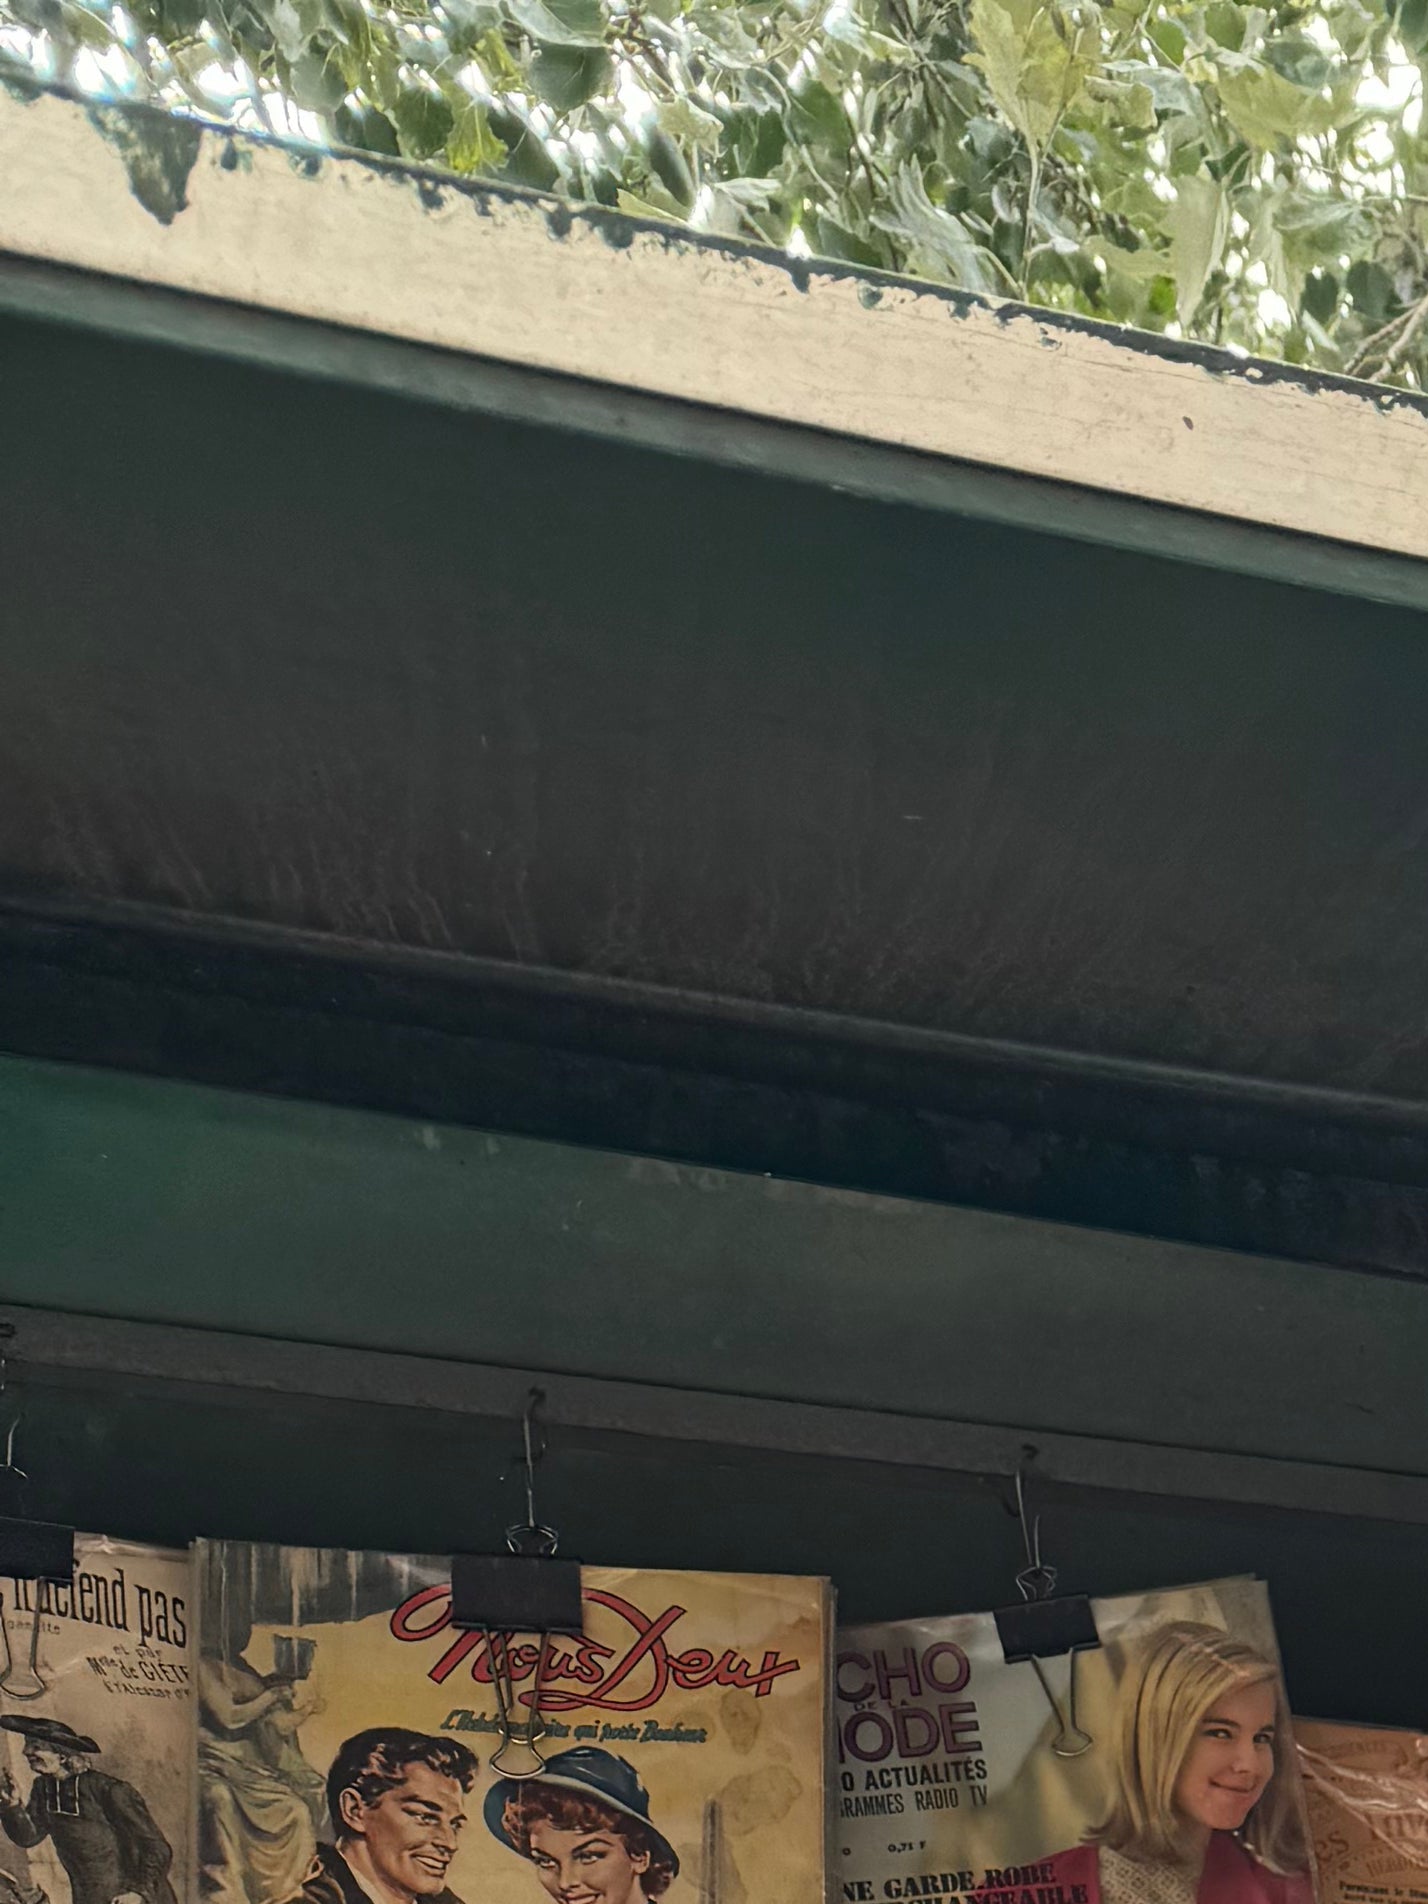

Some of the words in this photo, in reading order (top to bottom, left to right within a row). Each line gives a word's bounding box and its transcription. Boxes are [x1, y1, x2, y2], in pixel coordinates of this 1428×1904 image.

[134, 1583, 187, 1649] pas
[519, 1587, 802, 1712] Deux
[119, 1662, 139, 1679] de
[865, 1756, 988, 1792] ACTUALITÉS
[915, 1787, 960, 1812] RADIO
[970, 1785, 989, 1806] TV
